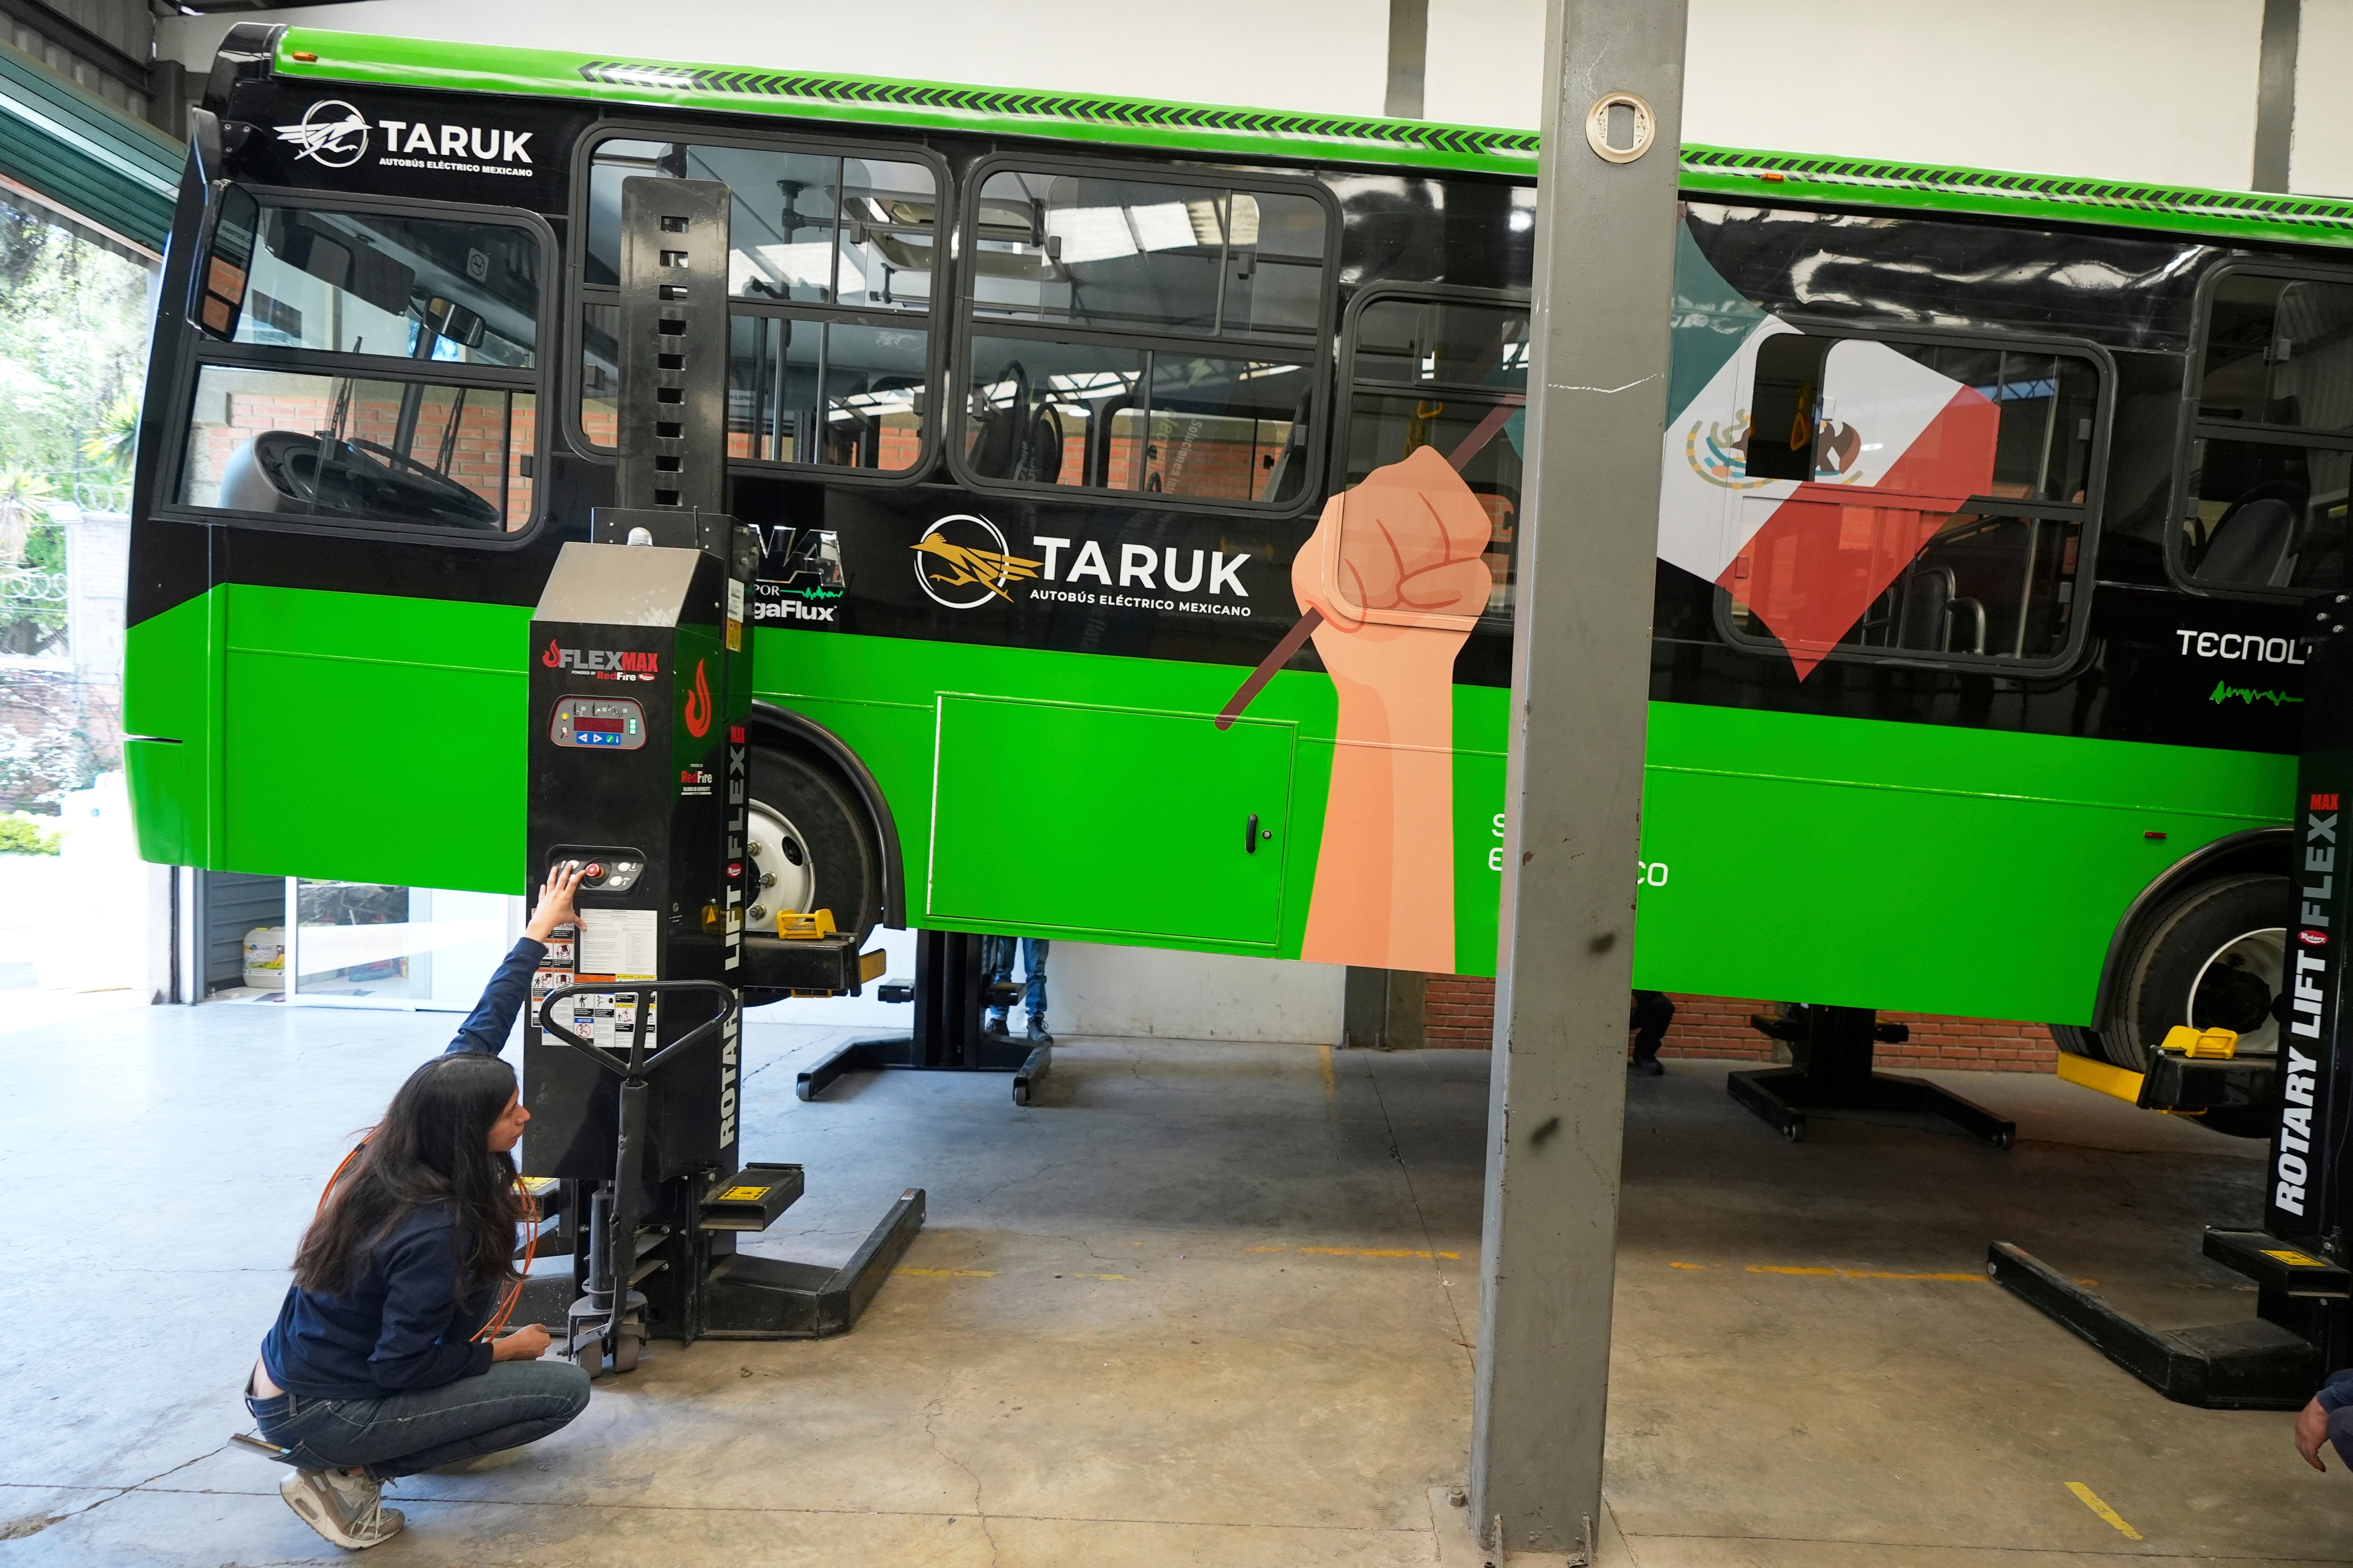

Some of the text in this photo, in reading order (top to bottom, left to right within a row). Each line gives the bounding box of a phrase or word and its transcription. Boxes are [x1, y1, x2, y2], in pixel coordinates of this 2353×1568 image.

[379, 121, 533, 163] TARUK
[379, 157, 533, 177] AUTOBÚS ELÉCTRICO MEXICANO
[1034, 536, 1251, 596] TARUK
[755, 600, 834, 622] gaFlux
[1031, 589, 1251, 616] AUTOBÚS ELÉCTRICO MEXICANO
[2176, 629, 2312, 664] TECNOL
[597, 672, 636, 681] RedFire
[682, 771, 712, 784] RedFire
[728, 746, 745, 859] FLEX
[2310, 793, 2339, 811] MAX
[2301, 813, 2338, 927] FLEX
[725, 885, 742, 971] LIFT
[2291, 949, 2326, 1039] LIFT
[720, 988, 738, 1149] ROTAR
[2275, 1046, 2317, 1217] ROTARY
